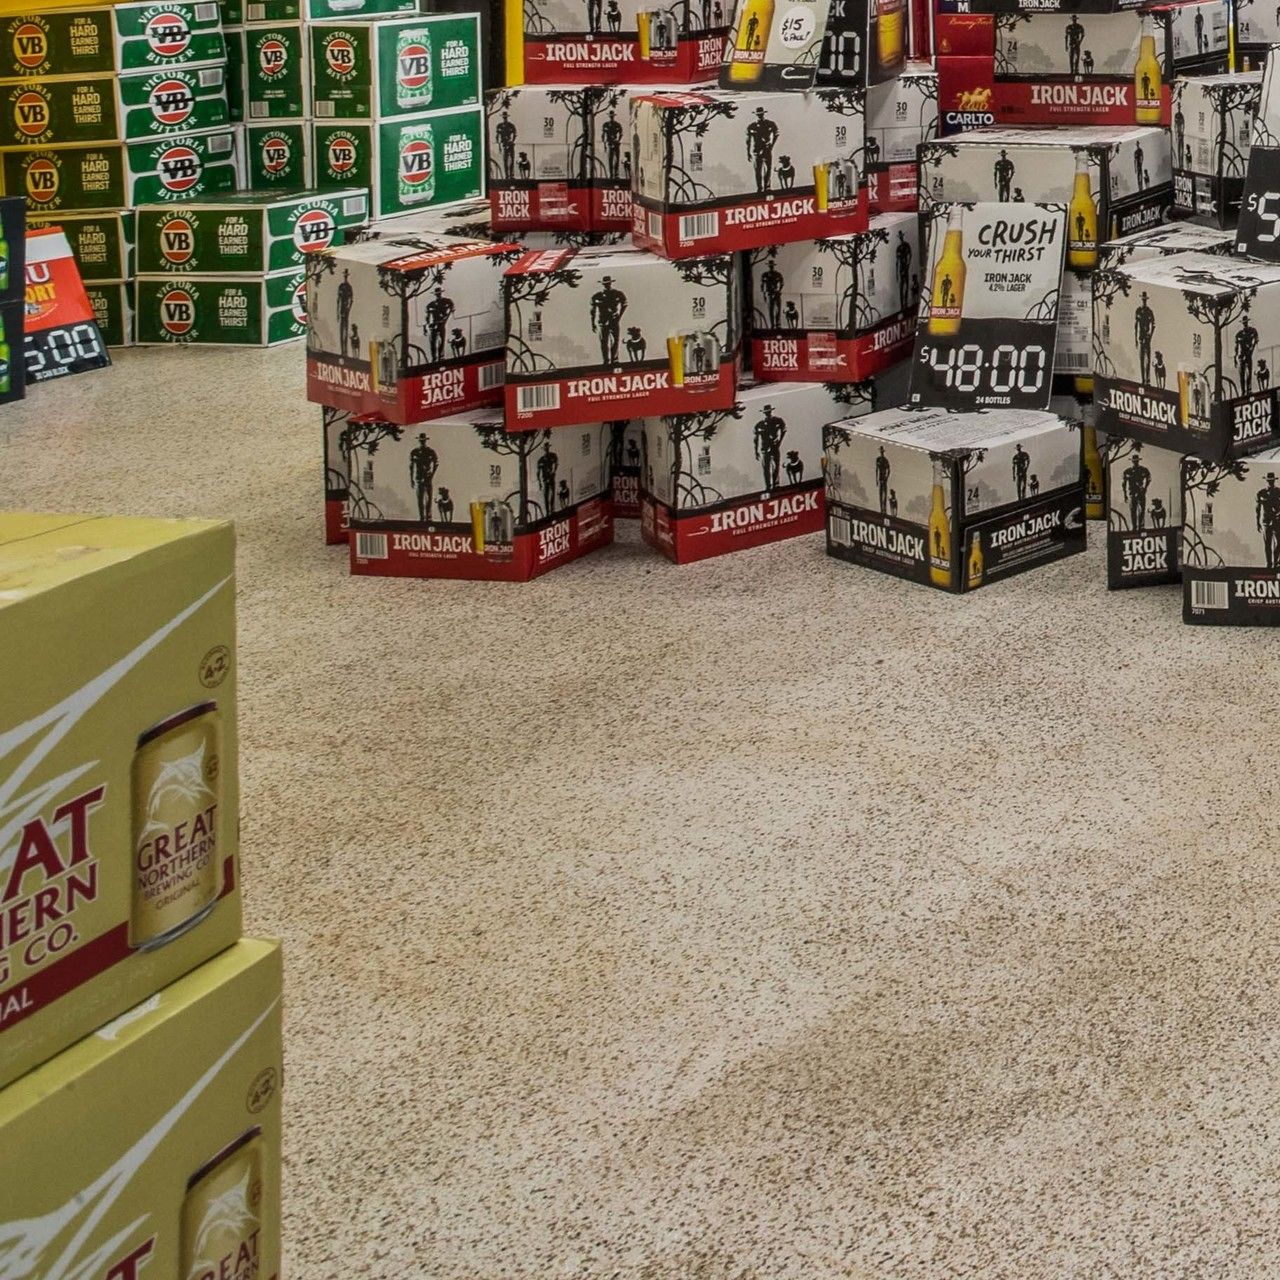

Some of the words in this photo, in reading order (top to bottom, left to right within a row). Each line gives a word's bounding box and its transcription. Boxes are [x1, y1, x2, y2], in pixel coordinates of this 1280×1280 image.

[782, 18, 804, 35] $15
[546, 44, 593, 61] IRON
[593, 44, 634, 62] JACK
[1031, 86, 1081, 104] IRON
[1081, 87, 1127, 106] JACK
[499, 190, 529, 204] IRON
[498, 203, 529, 218] JACK
[725, 206, 772, 226] IRON
[772, 198, 814, 219] JACK
[978, 218, 1056, 247] CRUSH
[968, 247, 992, 260] YOUR
[994, 245, 1045, 264] THIRST
[984, 273, 1008, 283] IRON
[1008, 273, 1032, 284] JACK
[1006, 282, 1026, 292] LAGER
[976, 396, 985, 404] 24
[986, 396, 1011, 405] BOTTLES
[710, 500, 766, 533] IRON
[767, 493, 818, 518] JACK
[136, 804, 217, 871] GREAT
[138, 835, 216, 888] NORTHERN
